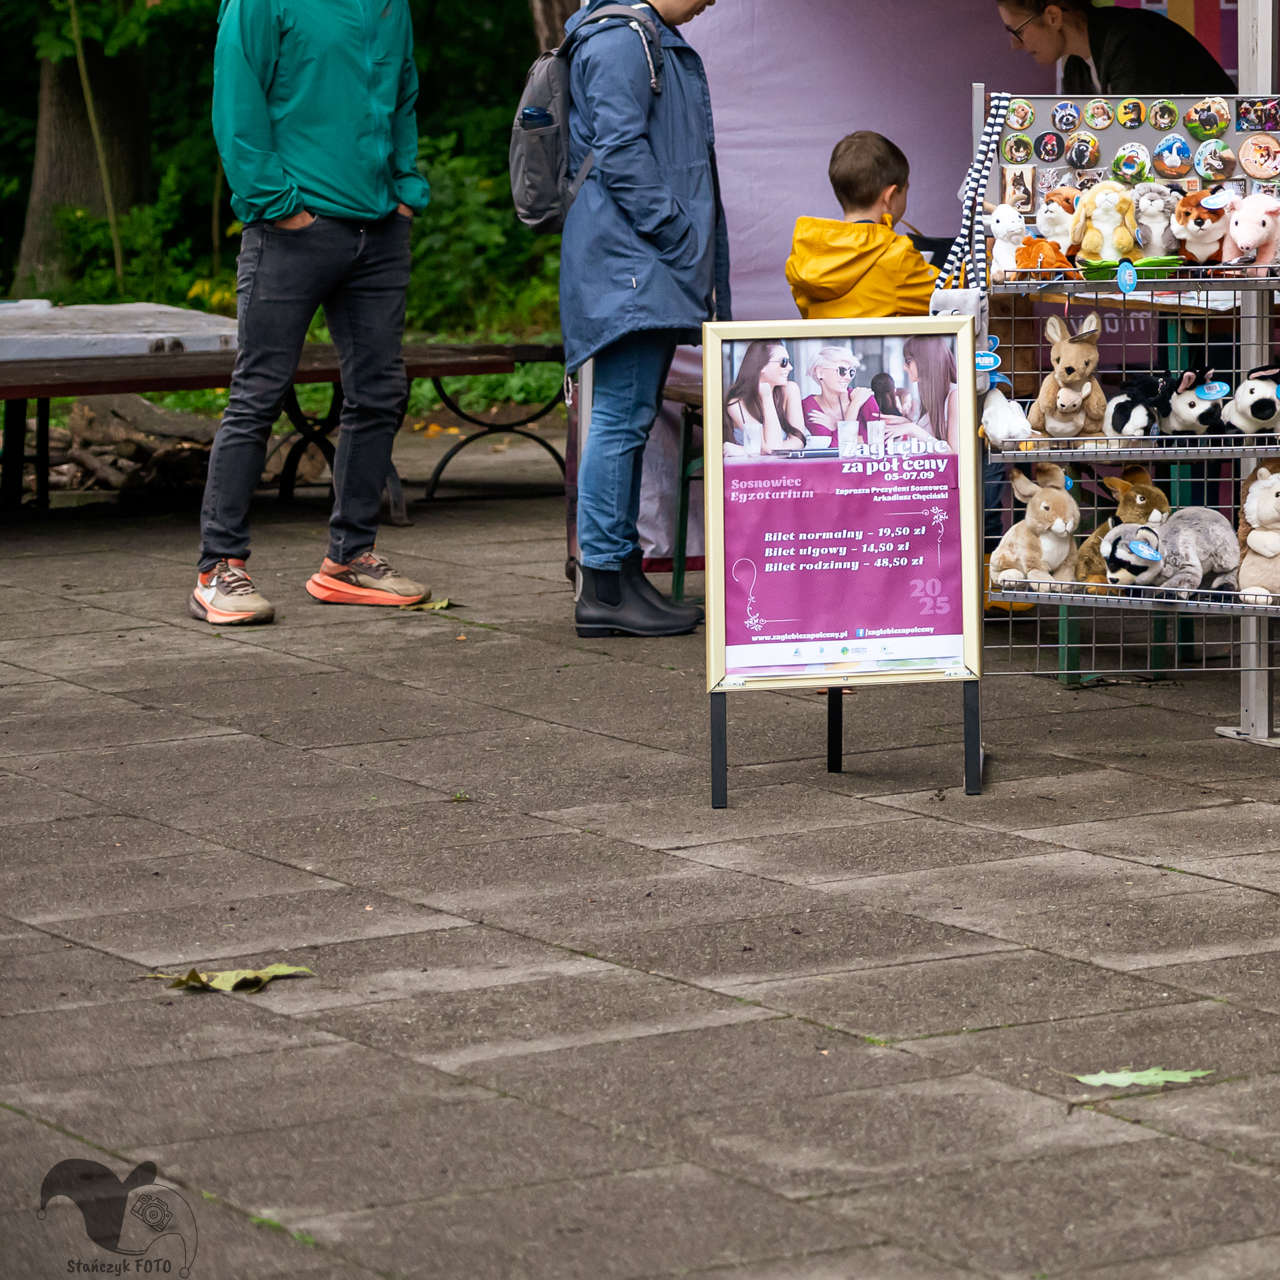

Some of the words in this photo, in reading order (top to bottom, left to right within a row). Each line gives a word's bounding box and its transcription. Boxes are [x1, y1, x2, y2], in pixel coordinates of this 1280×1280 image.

[841, 437, 948, 460] Zagłębie
[841, 462, 864, 473] za
[866, 457, 900, 475] pół
[902, 458, 949, 473] ceny
[731, 477, 802, 489] Sosnowiec
[884, 471, 935, 481] 05-07.09
[730, 489, 814, 504] Egzotarium
[835, 487, 870, 496] Zaprasza
[871, 485, 909, 494] Prezydent
[910, 484, 949, 492] Sosnowca
[873, 494, 912, 502] Arkadiusz
[912, 492, 949, 501] Chęciński
[764, 532, 795, 542] Bilet
[799, 530, 864, 541] normalny
[878, 527, 911, 538] 19,50
[914, 526, 926, 536] zł
[764, 547, 795, 557] Bilet
[799, 545, 848, 557] ulgowy
[862, 542, 894, 553] 14,50
[897, 542, 910, 552] zł
[764, 562, 796, 572] Bilet
[799, 560, 860, 573] rodzinny
[874, 557, 908, 568] 48,50
[911, 556, 924, 566] zł
[909, 578, 942, 597] 20
[918, 596, 950, 615] 25
[751, 630, 848, 642] www.zaglebiezapolceny.pl
